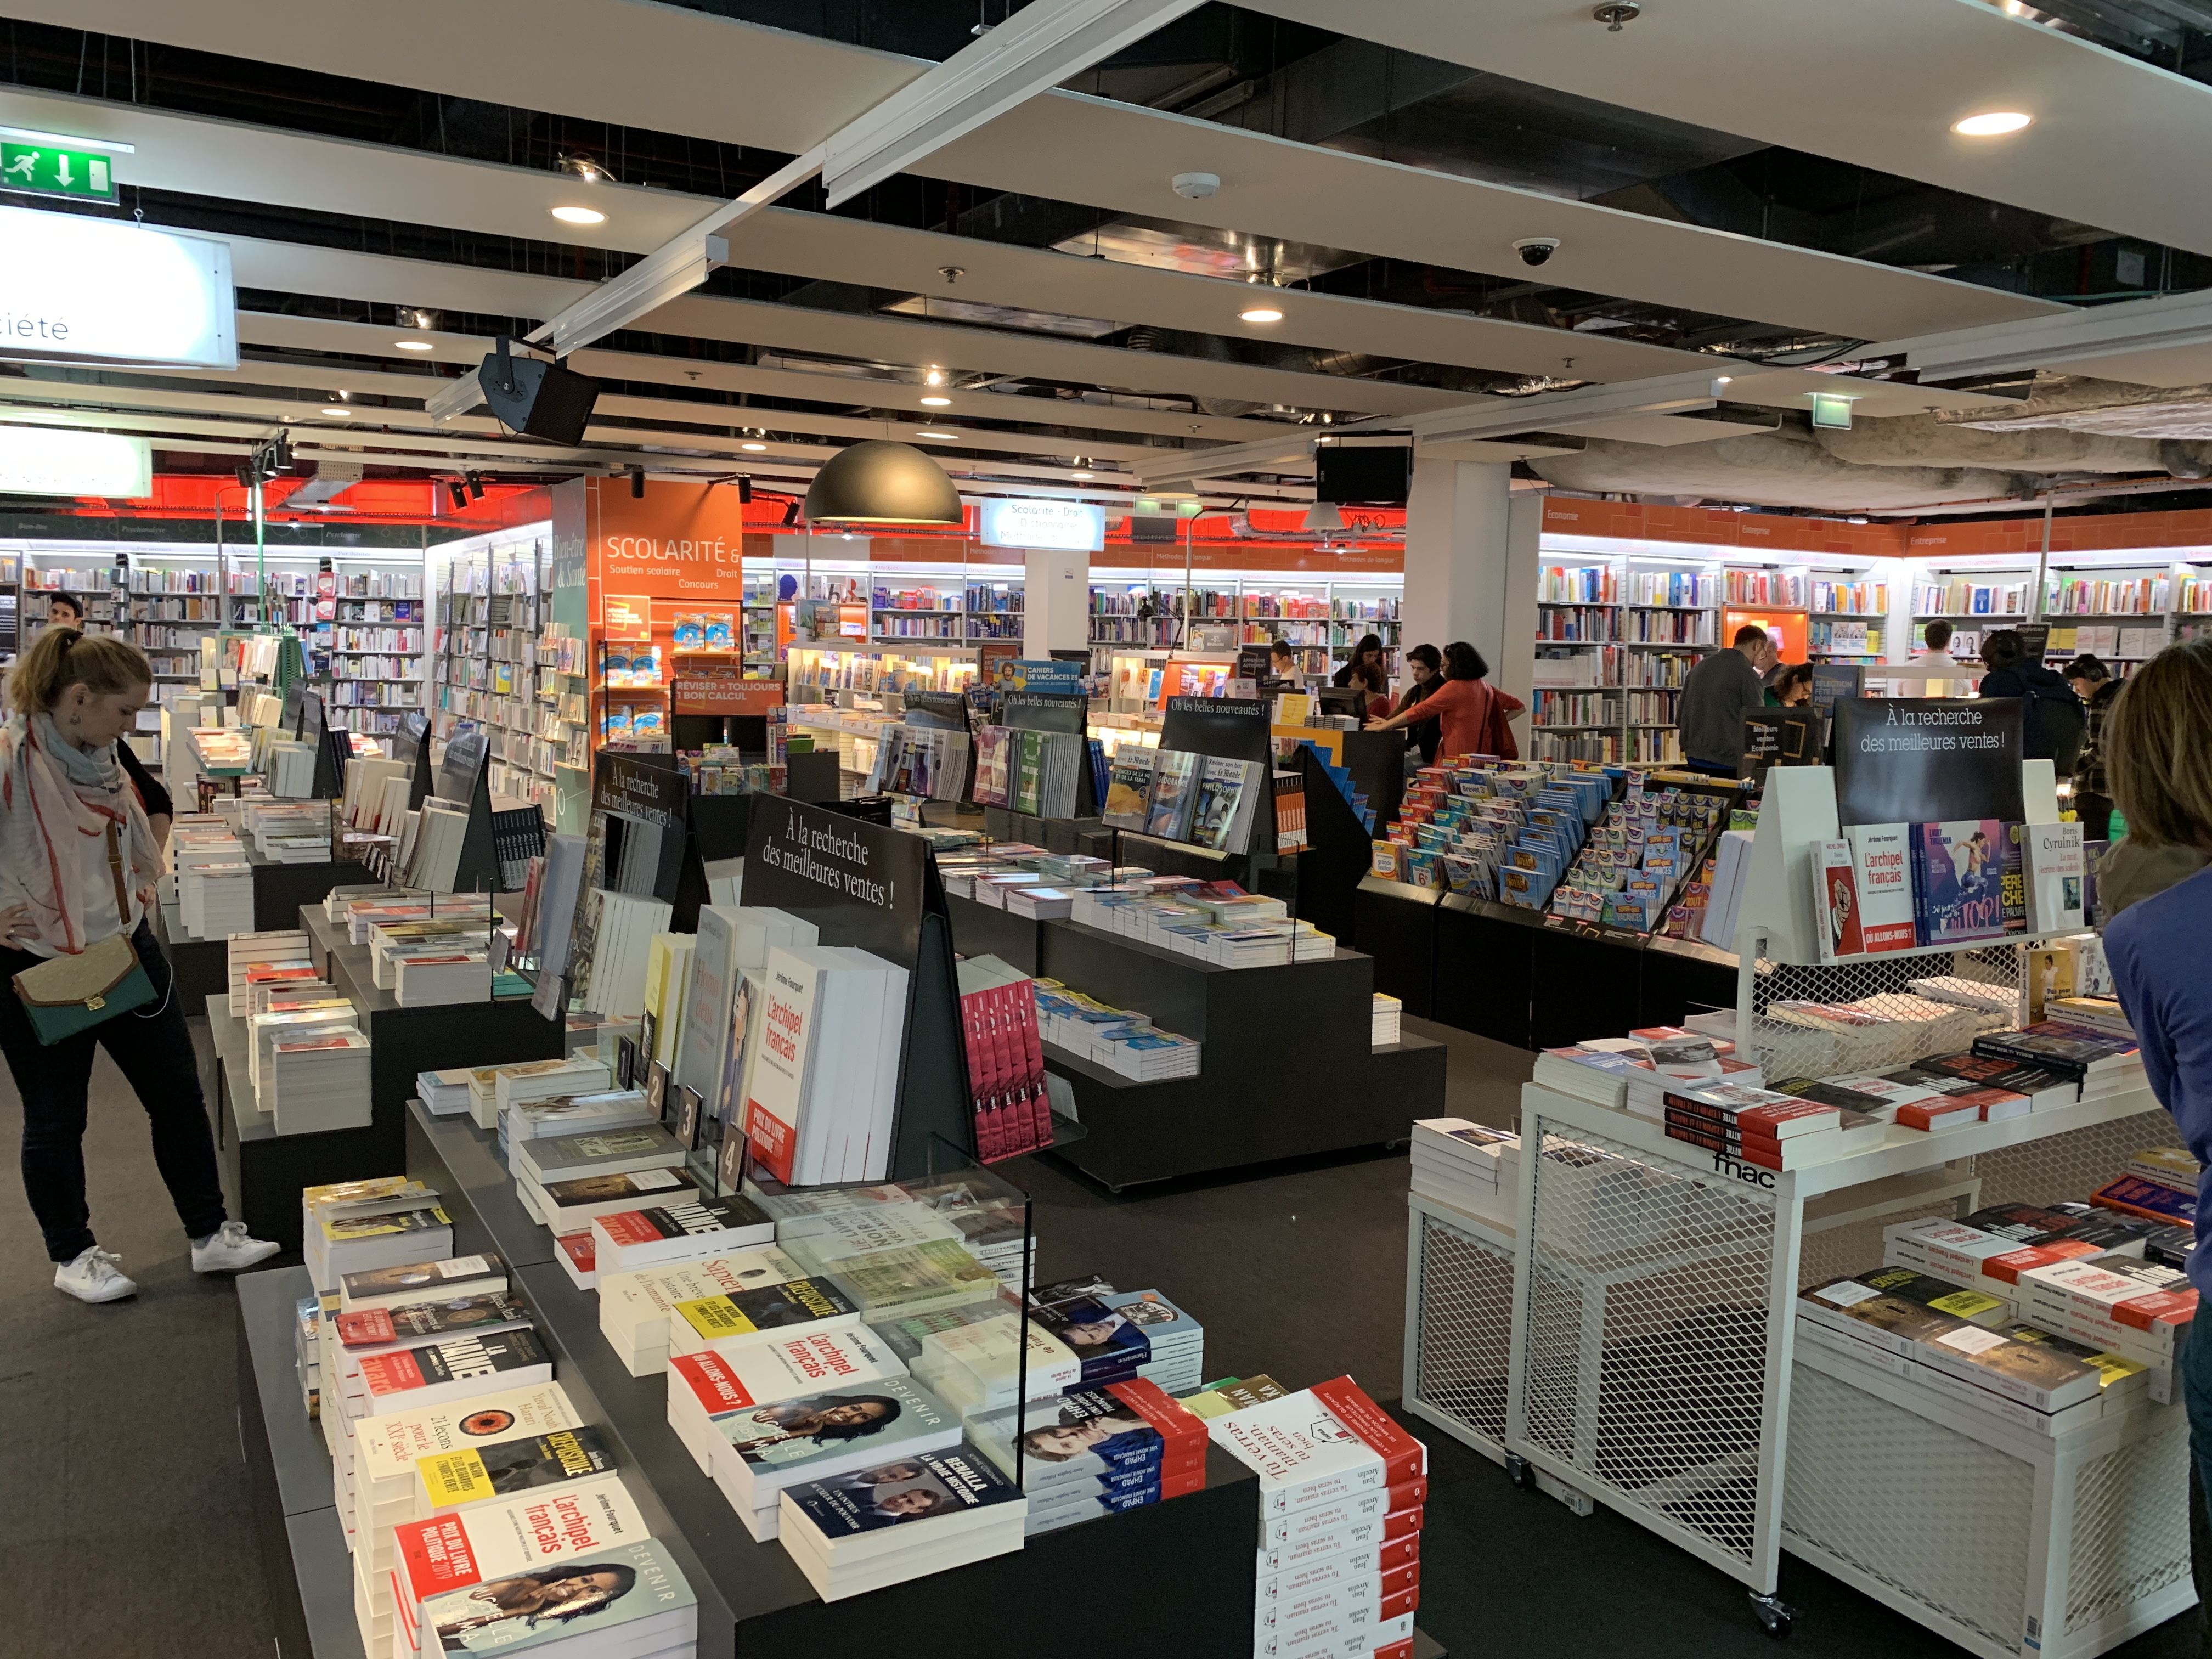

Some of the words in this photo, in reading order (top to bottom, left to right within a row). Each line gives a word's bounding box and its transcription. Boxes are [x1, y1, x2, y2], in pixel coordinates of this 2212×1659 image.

[0, 312, 68, 340] iété
[1012, 504, 1054, 515] Scolarité
[1064, 507, 1083, 517] Droit
[1547, 509, 1579, 521] Economie
[554, 532, 584, 561] Bien-être
[1910, 535, 1948, 546] Entreprise
[607, 536, 726, 563] SCOLARITÉ
[730, 549, 740, 563] &
[1339, 556, 1367, 564] Méthodes
[557, 568, 565, 588] &
[566, 560, 586, 588] Santé
[610, 565, 644, 575] Soutien
[646, 566, 681, 577] scolaire
[716, 568, 738, 578] Droit
[678, 579, 719, 589] Concours
[676, 680, 717, 691] RÉVISER
[727, 682, 781, 692] TOUJOURS
[676, 691, 681, 699] 1
[683, 692, 707, 700] BON
[707, 692, 747, 701] CALCUL
[1008, 694, 1018, 706] Oh
[1018, 695, 1026, 706] les
[1028, 695, 1043, 707] belles
[1043, 697, 1076, 709] nouveautés
[1171, 699, 1182, 711] Oh
[1183, 700, 1193, 712] les
[1194, 701, 1214, 713] belles
[1216, 703, 1259, 716] nouveautés
[1261, 704, 1265, 716] !
[1886, 703, 1899, 726] À
[1901, 708, 1915, 726] la
[1917, 708, 1982, 725] recherche
[1119, 746, 1134, 754] Réviser
[1751, 744, 1779, 752] Economie
[1861, 734, 1885, 753] des
[1888, 733, 1956, 752] meilleures
[1958, 735, 2000, 749] ventes
[2000, 731, 2005, 748] !
[1127, 755, 1133, 764] Le
[1133, 756, 1150, 766] Monde
[1209, 758, 1225, 768] Réviser
[1157, 775, 1189, 788] GÉOGRAPHIE
[1217, 769, 1223, 777] Le
[1223, 769, 1241, 780] Monde
[785, 805, 795, 841] À
[798, 815, 808, 845] la
[810, 824, 868, 866] recherche
[1881, 834, 1898, 843] Fourquet
[2062, 827, 2078, 836] Boris
[2042, 836, 2081, 852] Cyrulnik
[2059, 853, 2067, 861] La
[2067, 853, 2079, 863] nuit,
[763, 835, 781, 866] des
[782, 848, 840, 889] meilleures
[844, 873, 884, 906] ventes
[889, 880, 894, 910] !
[1866, 932, 1874, 944] OÙ
[1874, 929, 1908, 943] ALLONS-NOUS
[1908, 929, 1912, 939] ?
[620, 1049, 627, 1076] 1
[1940, 1054, 1980, 1069] BAD
[1958, 1059, 2019, 1081] BLOOD
[649, 1074, 660, 1108] 2
[682, 1103, 693, 1137] 3
[724, 1139, 736, 1175] 4
[1712, 1151, 1776, 1189] fnac
[708, 1207, 730, 1216] LA
[659, 1277, 684, 1300] histoire
[676, 1271, 688, 1282] Une
[686, 1280, 707, 1300] brève
[436, 1336, 497, 1381] HAINE
[485, 1344, 507, 1356] LA
[1118, 1351, 1148, 1364] Flammarion
[532, 1392, 545, 1412] Yuval
[540, 1409, 559, 1430] Noah
[883, 1379, 941, 1426] DEVENIR
[430, 1415, 442, 1425] 21
[517, 1402, 537, 1427] Harari
[407, 1423, 426, 1442] pour
[422, 1440, 430, 1451] le
[434, 1423, 454, 1450] leçons
[756, 1409, 806, 1459] MICHELLE
[1223, 1421, 1267, 1462] verras
[1267, 1425, 1297, 1450] seras
[1292, 1431, 1315, 1450] bien
[545, 1430, 594, 1477] CRÉPUSCULE
[1133, 1448, 1148, 1456] HONTE
[1250, 1424, 1299, 1467] maman,
[1113, 1451, 1133, 1460] FRANÇAISE
[1125, 1454, 1146, 1465] EHPAD
[1294, 1450, 1311, 1460] tu
[452, 1460, 461, 1469] LES
[466, 1460, 486, 1479] MACRON
[1265, 1462, 1289, 1480] Tu
[1358, 1467, 1380, 1477] Arcelin
[455, 1467, 475, 1492] OLIGARQUES
[919, 1454, 935, 1463] LA
[927, 1459, 952, 1477] VRAIE
[945, 1476, 980, 1505] HISTOIRE
[943, 1457, 988, 1492] BENALLA
[1362, 1477, 1375, 1485] Jean
[1302, 1483, 1317, 1493] bien
[1318, 1481, 1331, 1489] seras
[1319, 1488, 1340, 1498] verras
[596, 1493, 609, 1510] Jérôme
[1295, 1492, 1319, 1504] maman,
[438, 1521, 453, 1539] PRIX
[524, 1503, 562, 1555] français
[552, 1494, 601, 1553] L'archipel
[602, 1508, 624, 1535] Fourquet
[419, 1526, 448, 1566] POLITIQUE
[446, 1537, 459, 1550] DU
[431, 1556, 453, 1580] 2019
[449, 1548, 473, 1577] LIVRE
